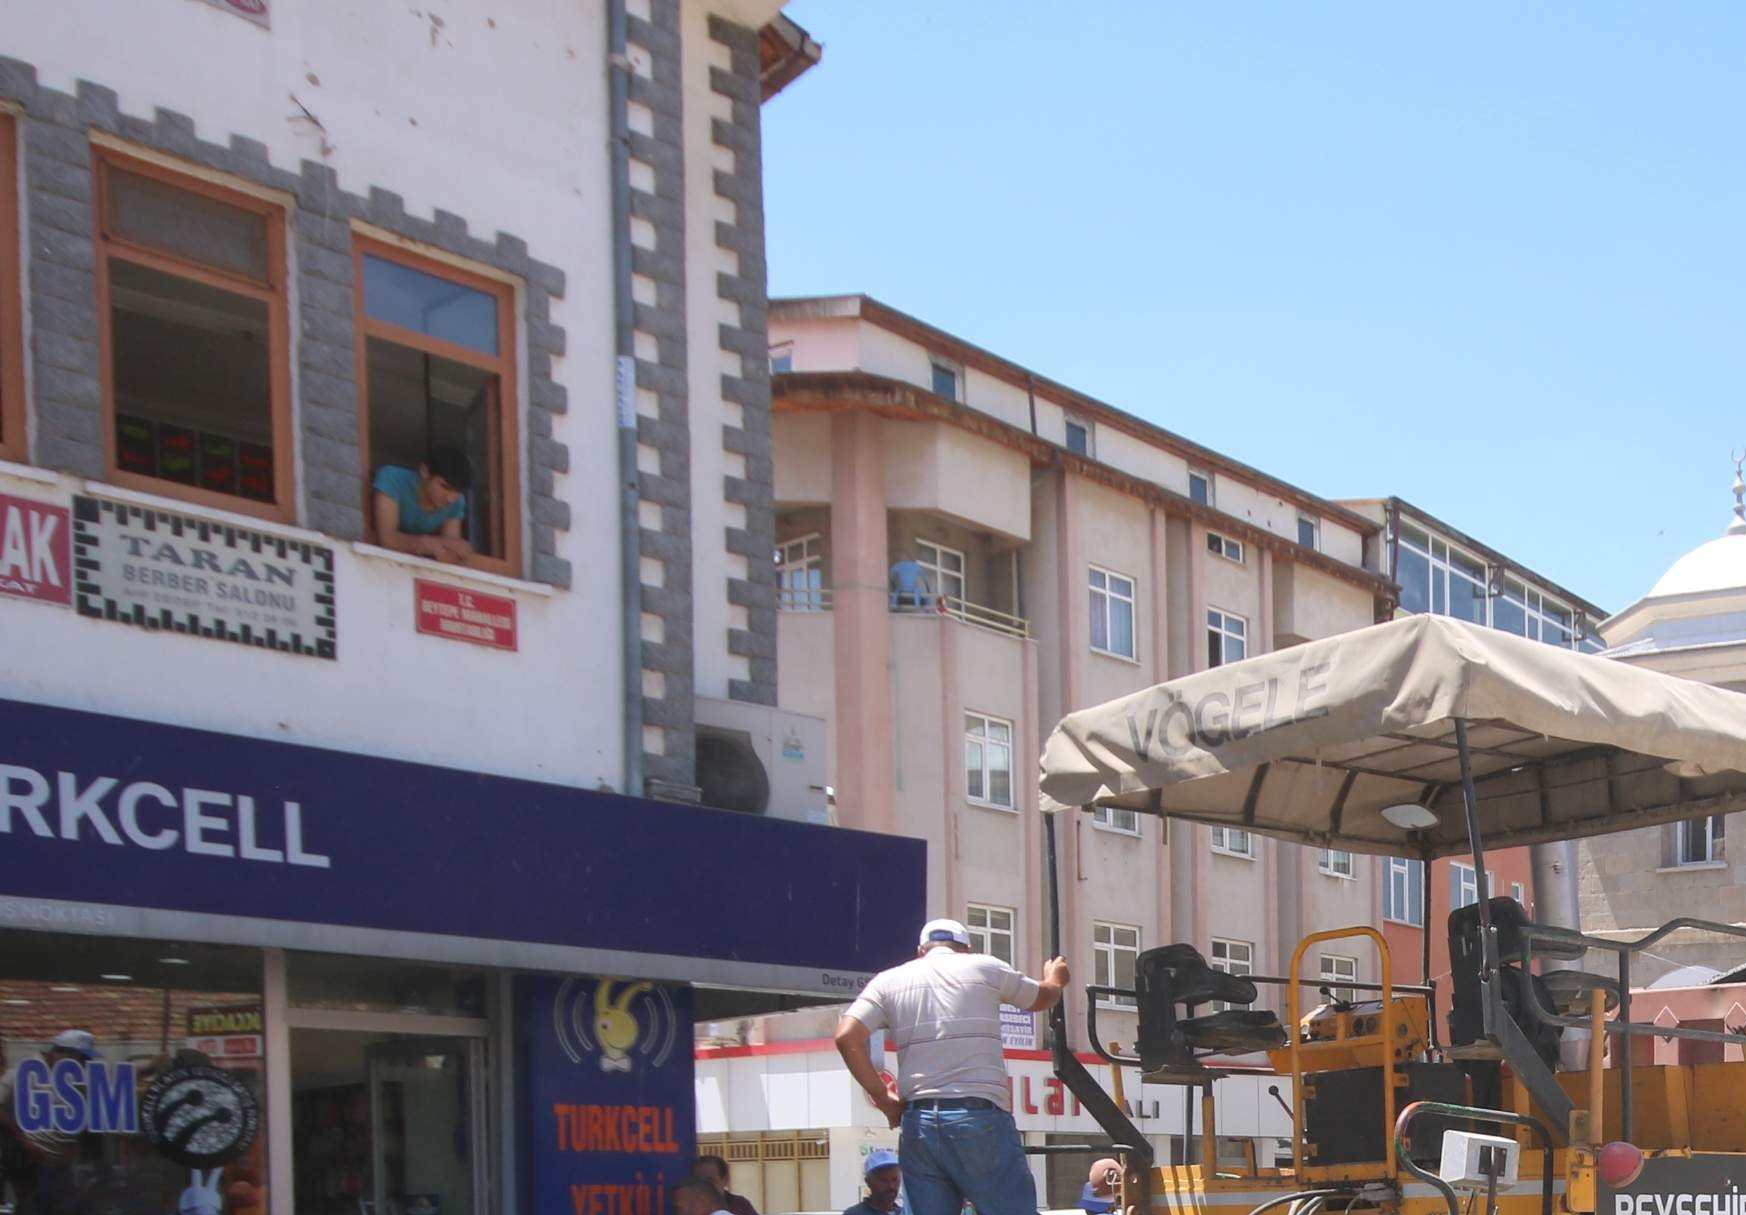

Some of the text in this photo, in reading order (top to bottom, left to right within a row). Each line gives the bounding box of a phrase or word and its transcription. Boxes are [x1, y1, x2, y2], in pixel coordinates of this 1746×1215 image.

[118, 533, 298, 588] TARAN
[121, 562, 209, 596] BERBER
[214, 580, 297, 613] SALONU
[1126, 663, 1331, 761] VÖGELE
[0, 763, 331, 869] RKCELL
[822, 972, 855, 990] Detay
[15, 1058, 139, 1135] GSM
[553, 1103, 680, 1154] TURKCELL
